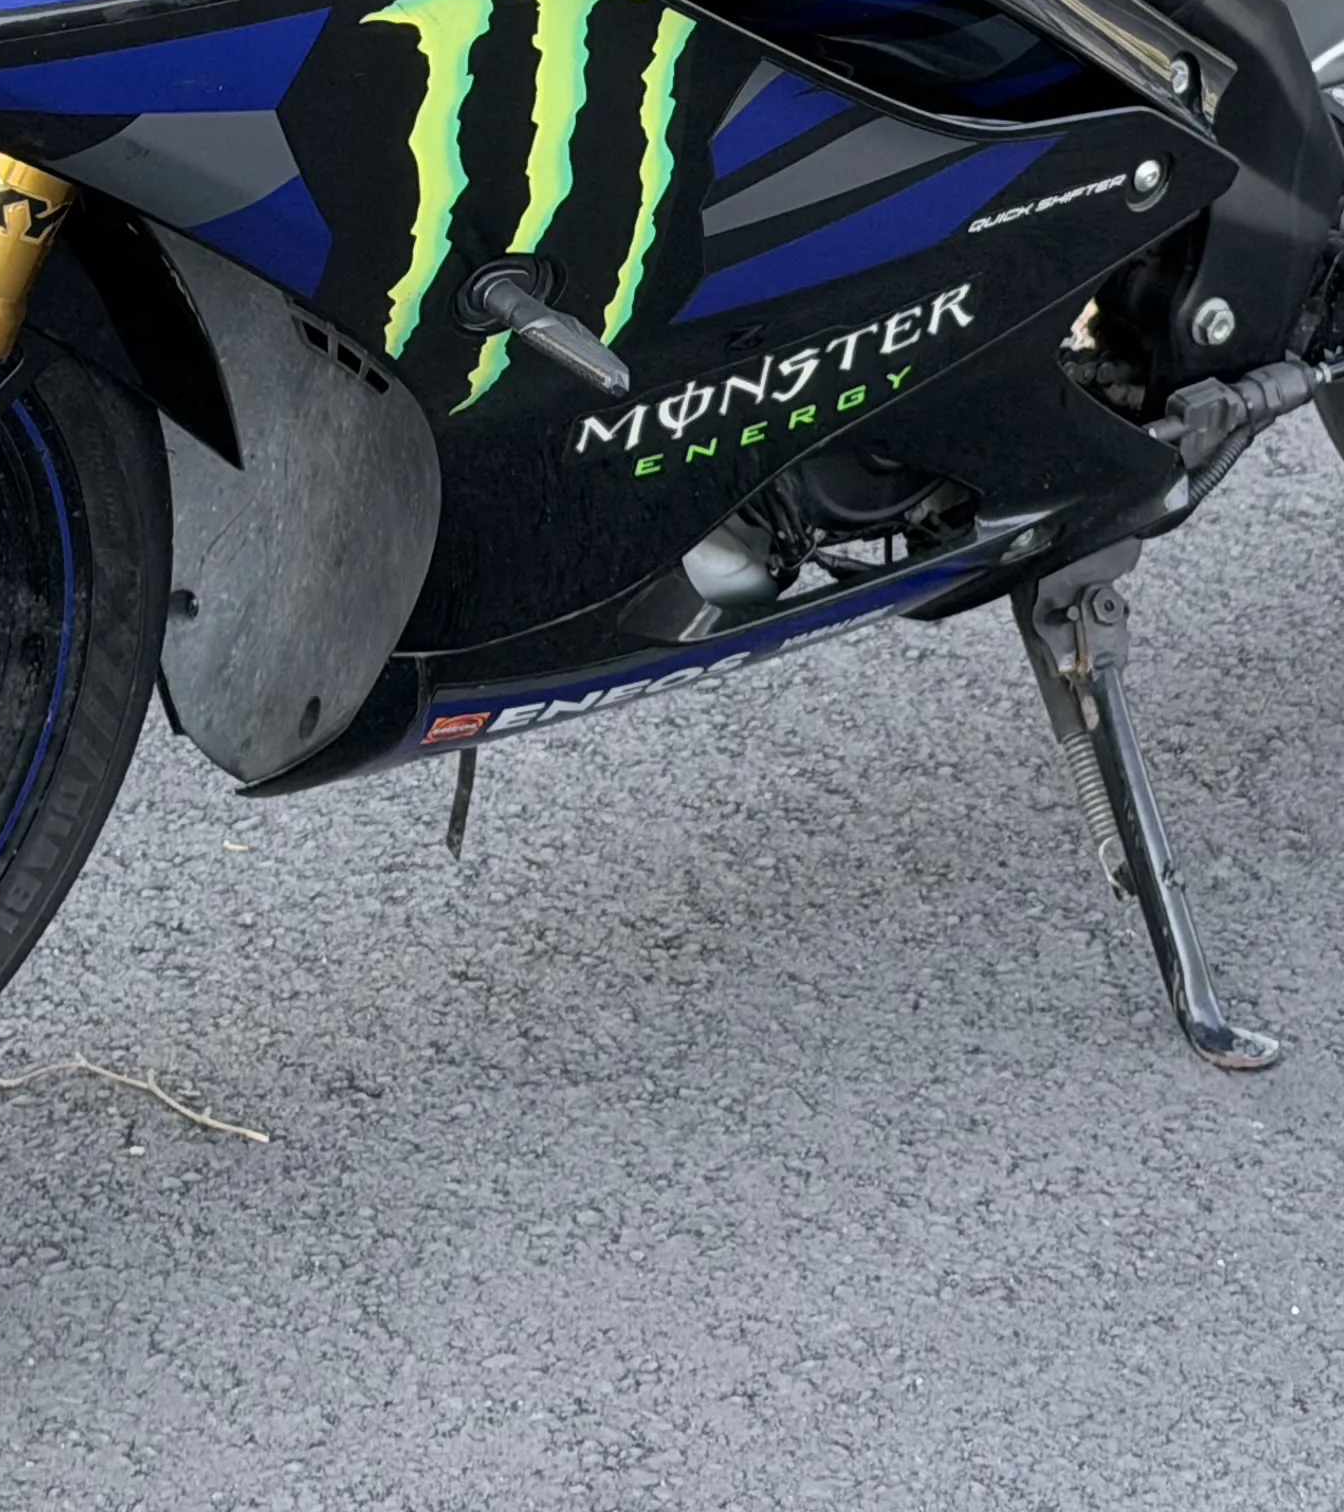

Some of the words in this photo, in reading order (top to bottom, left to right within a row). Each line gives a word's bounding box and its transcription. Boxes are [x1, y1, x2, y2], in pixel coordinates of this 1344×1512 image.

[967, 202, 1035, 233] QUICK
[1035, 173, 1127, 213] SHIFTER
[575, 283, 976, 454] MONSTER
[634, 365, 913, 478] ENERGY
[485, 650, 751, 734] ENEOS
